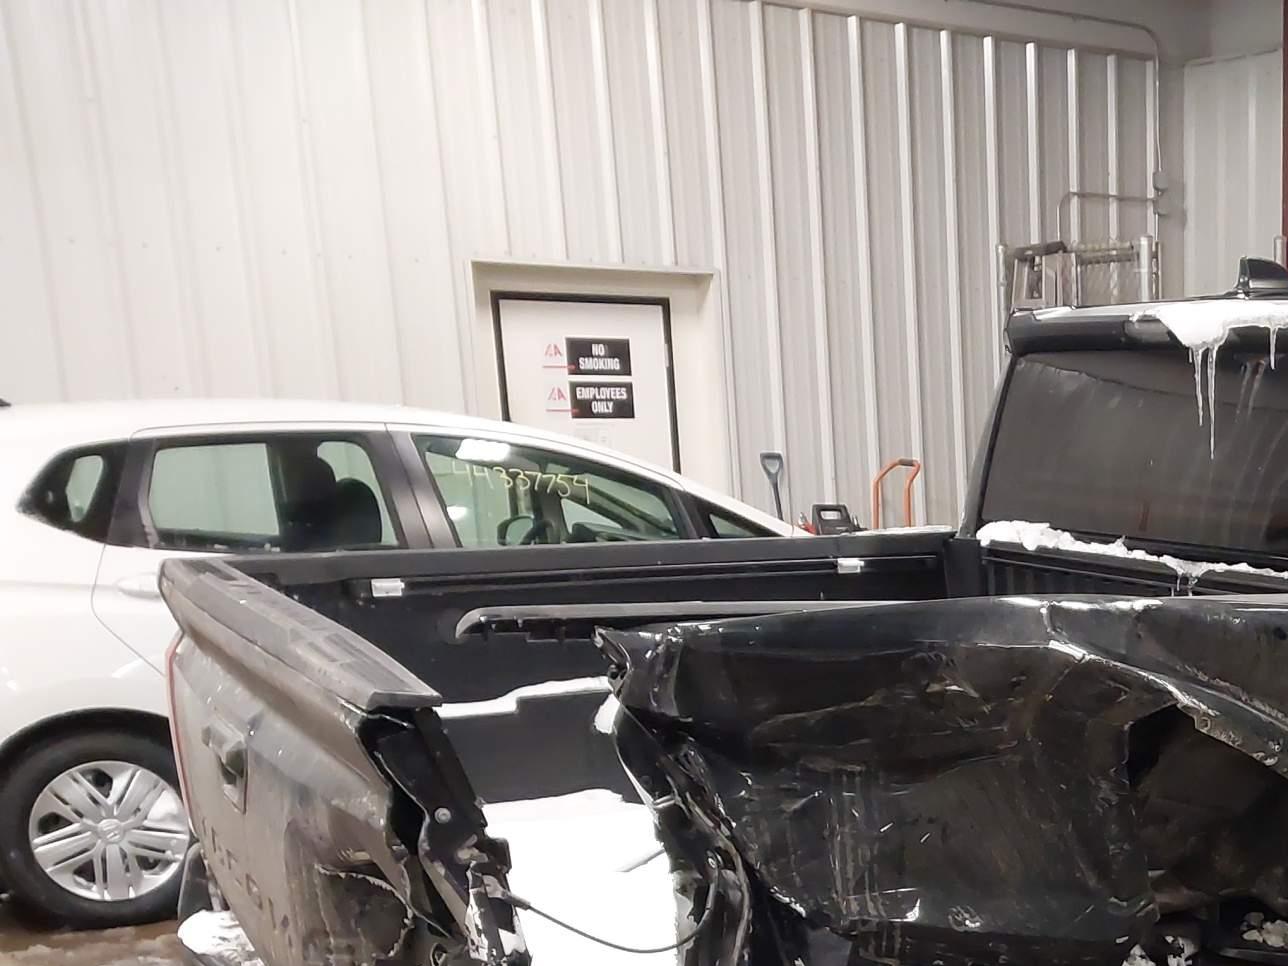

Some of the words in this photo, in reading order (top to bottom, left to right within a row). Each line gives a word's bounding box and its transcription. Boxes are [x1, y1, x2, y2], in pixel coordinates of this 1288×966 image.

[591, 343, 606, 356] NO
[579, 357, 620, 370] SMOKING
[576, 387, 627, 400] EMPLOYEES
[591, 401, 613, 414] ONLY
[452, 459, 590, 505] 44337754
